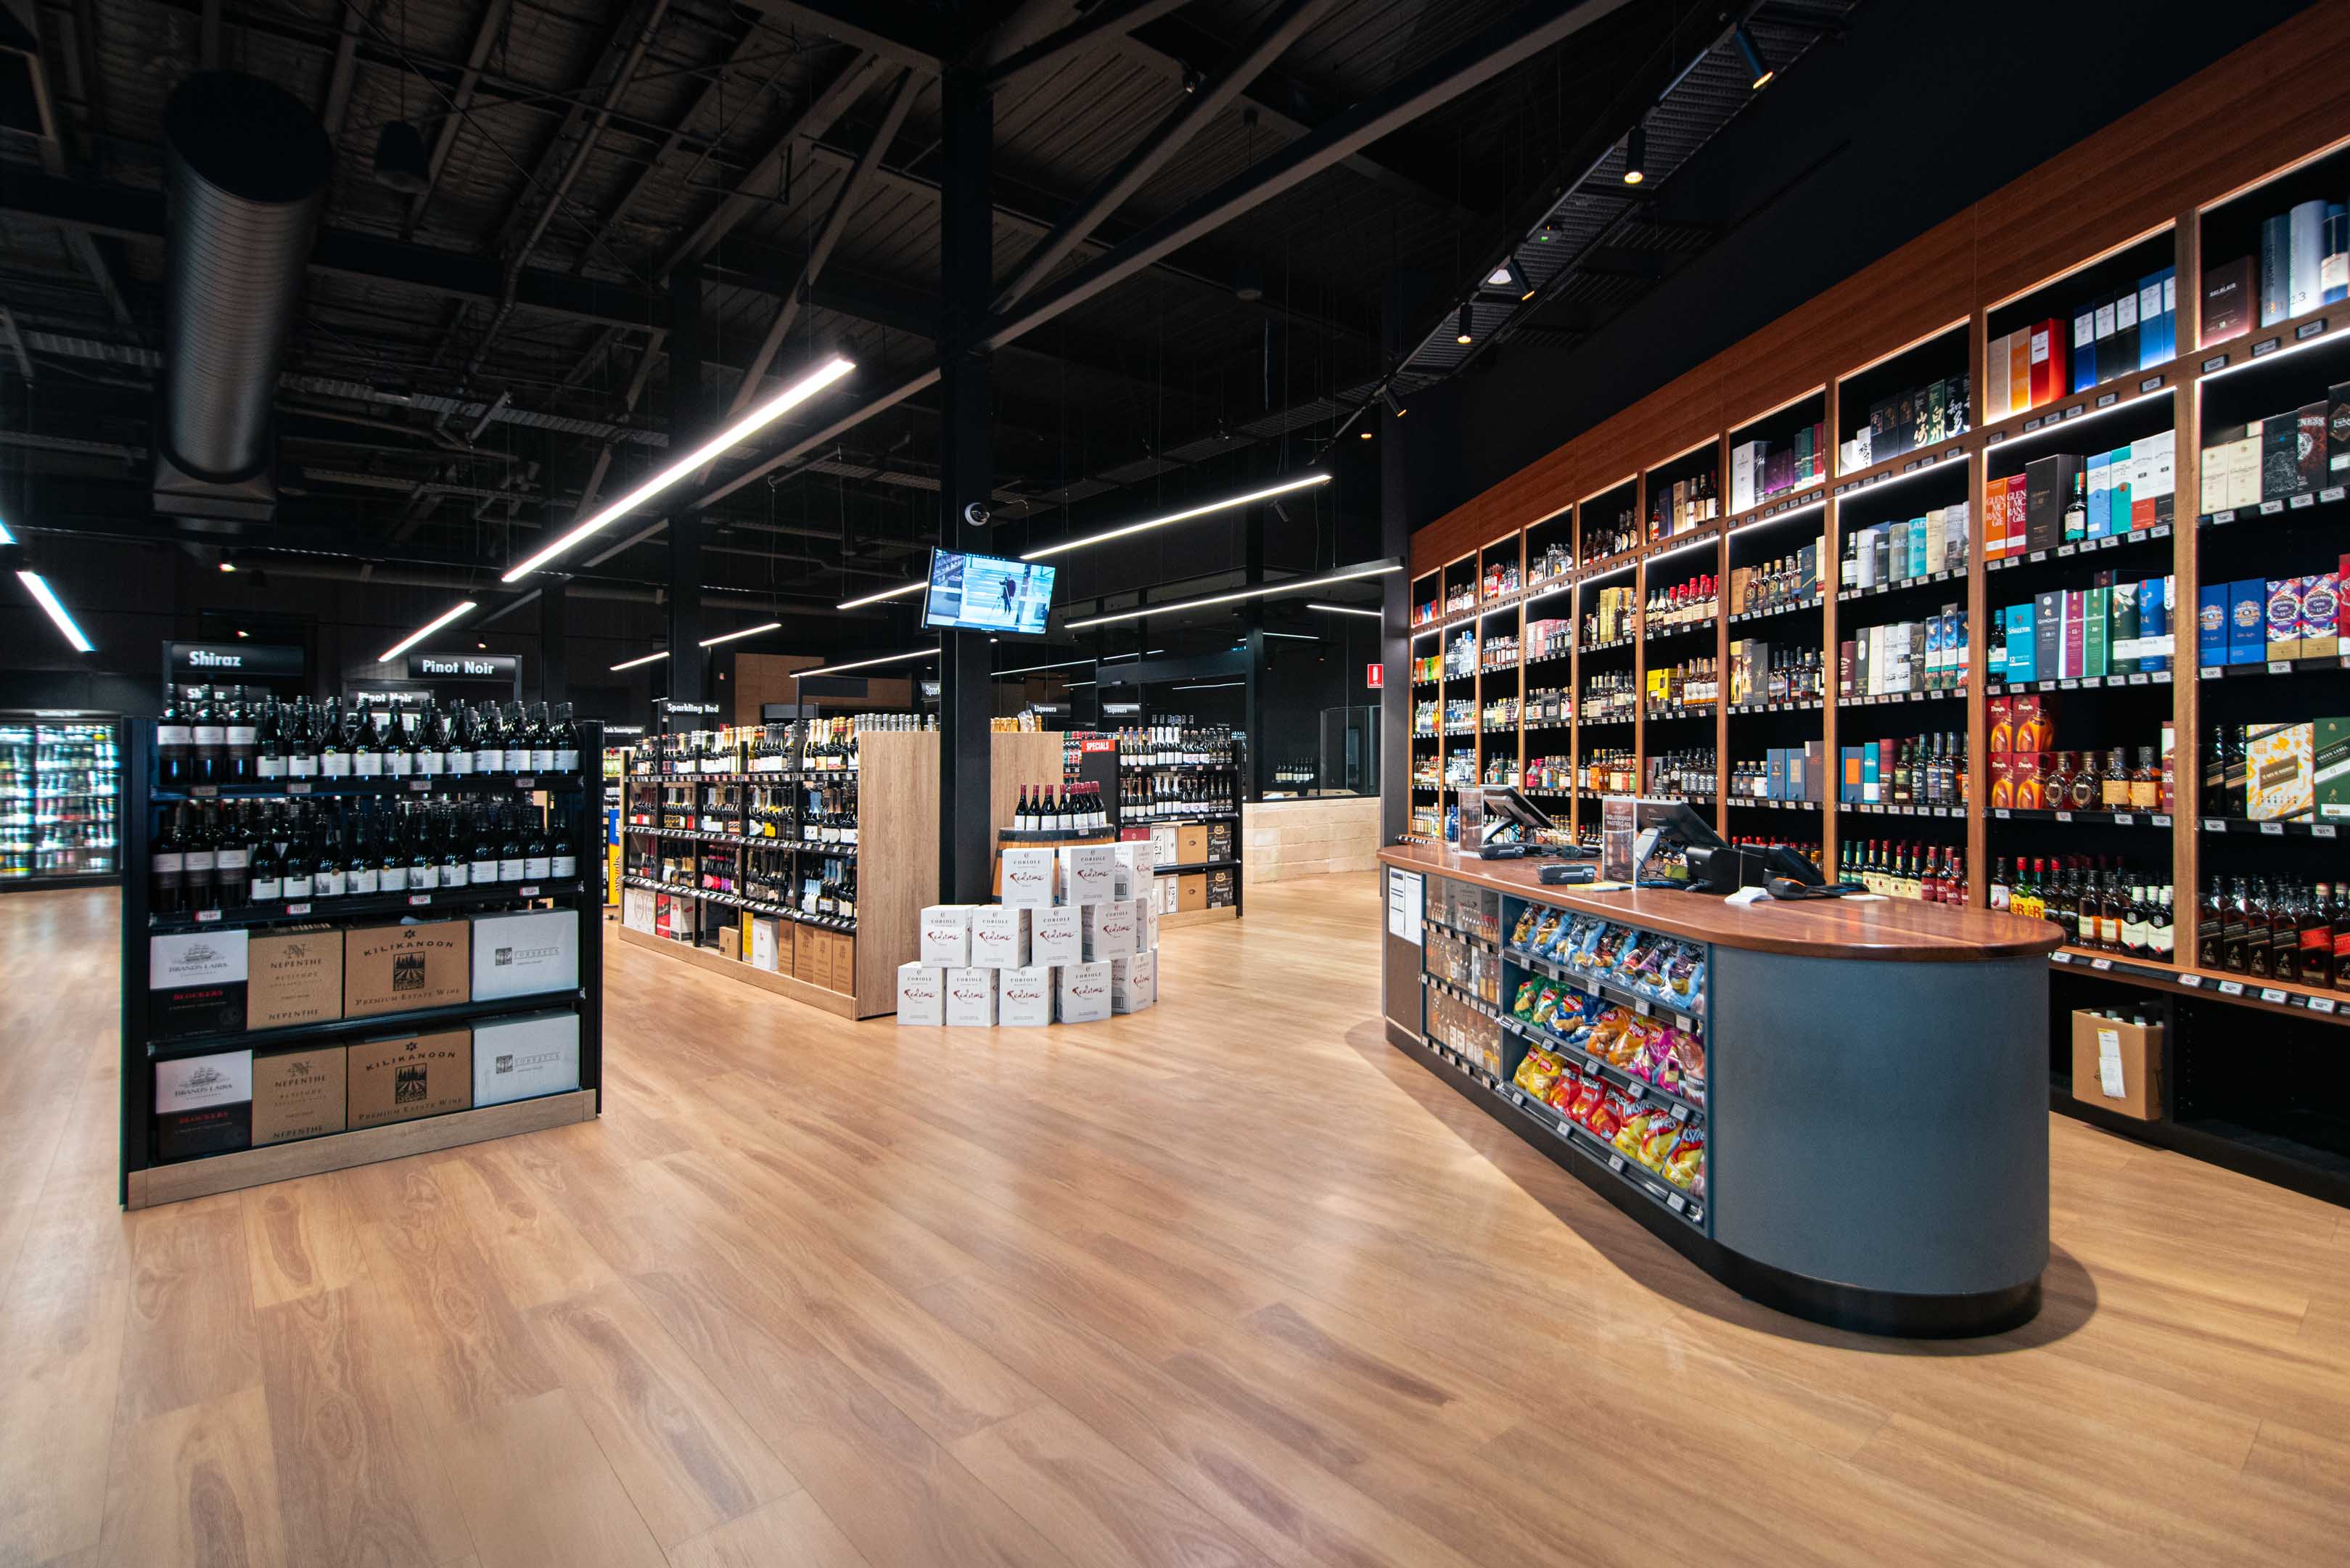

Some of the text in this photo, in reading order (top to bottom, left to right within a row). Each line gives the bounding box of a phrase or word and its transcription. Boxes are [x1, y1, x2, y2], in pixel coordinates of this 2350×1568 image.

[189, 651, 242, 666] Shiraz
[422, 660, 494, 674] Pinot Noir
[667, 703, 719, 714] Sparkling Red
[1086, 742, 1109, 752] SPECIALS
[363, 940, 453, 956] KILIKANOON
[271, 959, 324, 969] NEPENTHE
[366, 1051, 456, 1071] KILIKANOON
[275, 1075, 326, 1087] NEPENTHE
